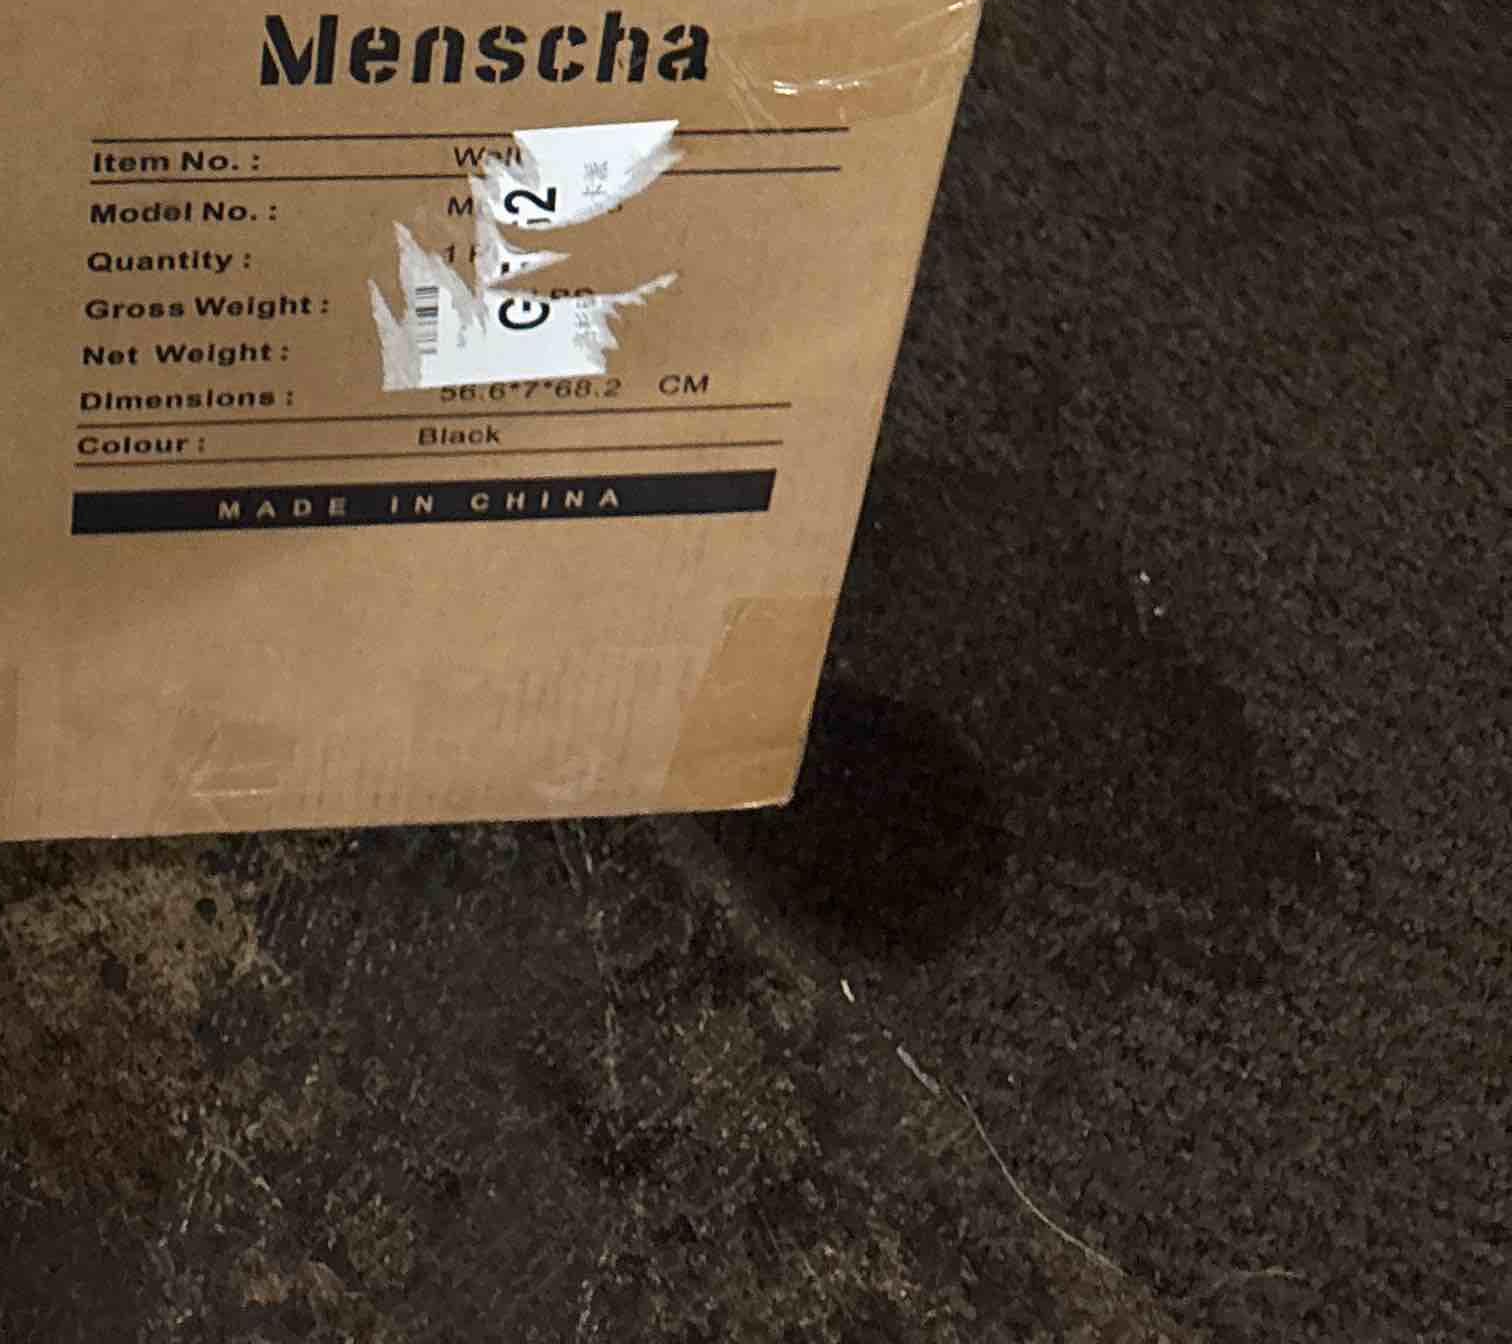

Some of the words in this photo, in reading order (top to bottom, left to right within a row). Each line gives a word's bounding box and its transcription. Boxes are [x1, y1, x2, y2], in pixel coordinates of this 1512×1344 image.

[258, 10, 713, 87] Menscha
[92, 151, 171, 174] Item
[89, 200, 193, 225] Model
[85, 297, 186, 320] Gross
[82, 345, 139, 367] Net
[656, 372, 711, 397] CM
[416, 423, 502, 447] Black
[217, 494, 350, 522] MADE
[389, 492, 435, 515] IN
[469, 487, 621, 513] CHINA
